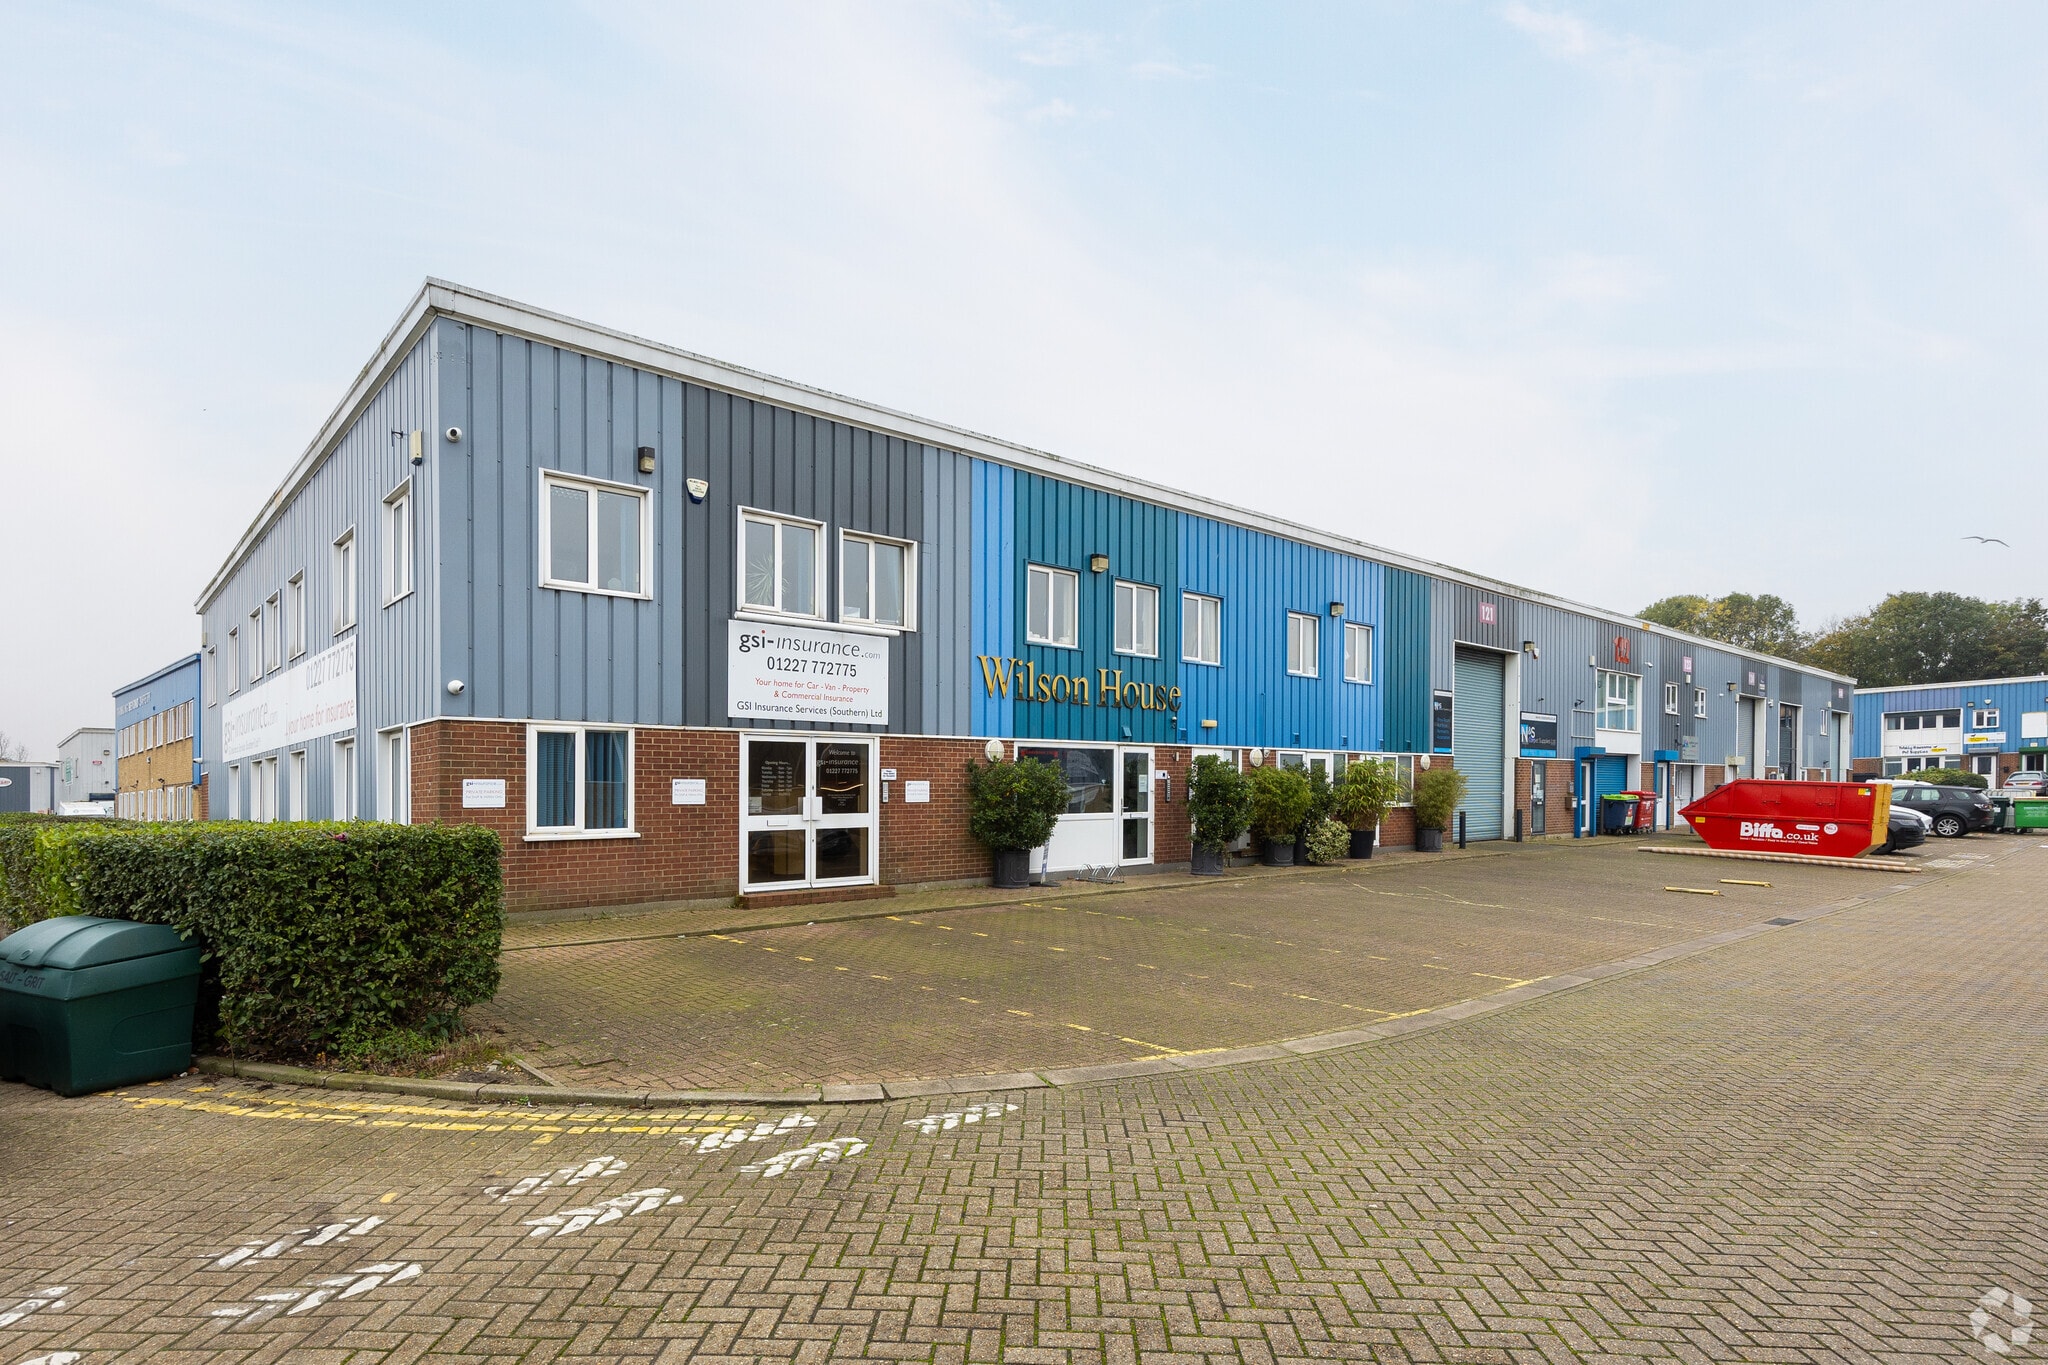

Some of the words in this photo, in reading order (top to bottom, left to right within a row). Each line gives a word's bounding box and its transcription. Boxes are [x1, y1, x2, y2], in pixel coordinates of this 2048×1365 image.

[1482, 605, 1493, 622] 121
[739, 629, 881, 660] gsi-insurance.com
[305, 656, 326, 690] 01227
[327, 642, 355, 680] 772775
[767, 656, 808, 673] 01227
[811, 660, 857, 677] 772775
[755, 677, 771, 686] Your
[773, 679, 793, 688] home
[794, 680, 805, 688] for
[806, 681, 819, 689] Car
[824, 683, 836, 691] Van
[842, 684, 870, 695] Property
[977, 655, 1090, 706] Wilson
[1097, 668, 1182, 712] House
[781, 690, 822, 701] Commercial
[823, 693, 854, 703] Insurance
[325, 699, 355, 723] insurance
[737, 700, 752, 711] GSI
[754, 702, 793, 713] Insurance
[795, 704, 827, 715] Services
[829, 705, 869, 717] (Southern)
[870, 708, 883, 718] Ltd
[1740, 821, 1819, 841] Biffa.co.uk
[24, 975, 45, 990] GRIT
